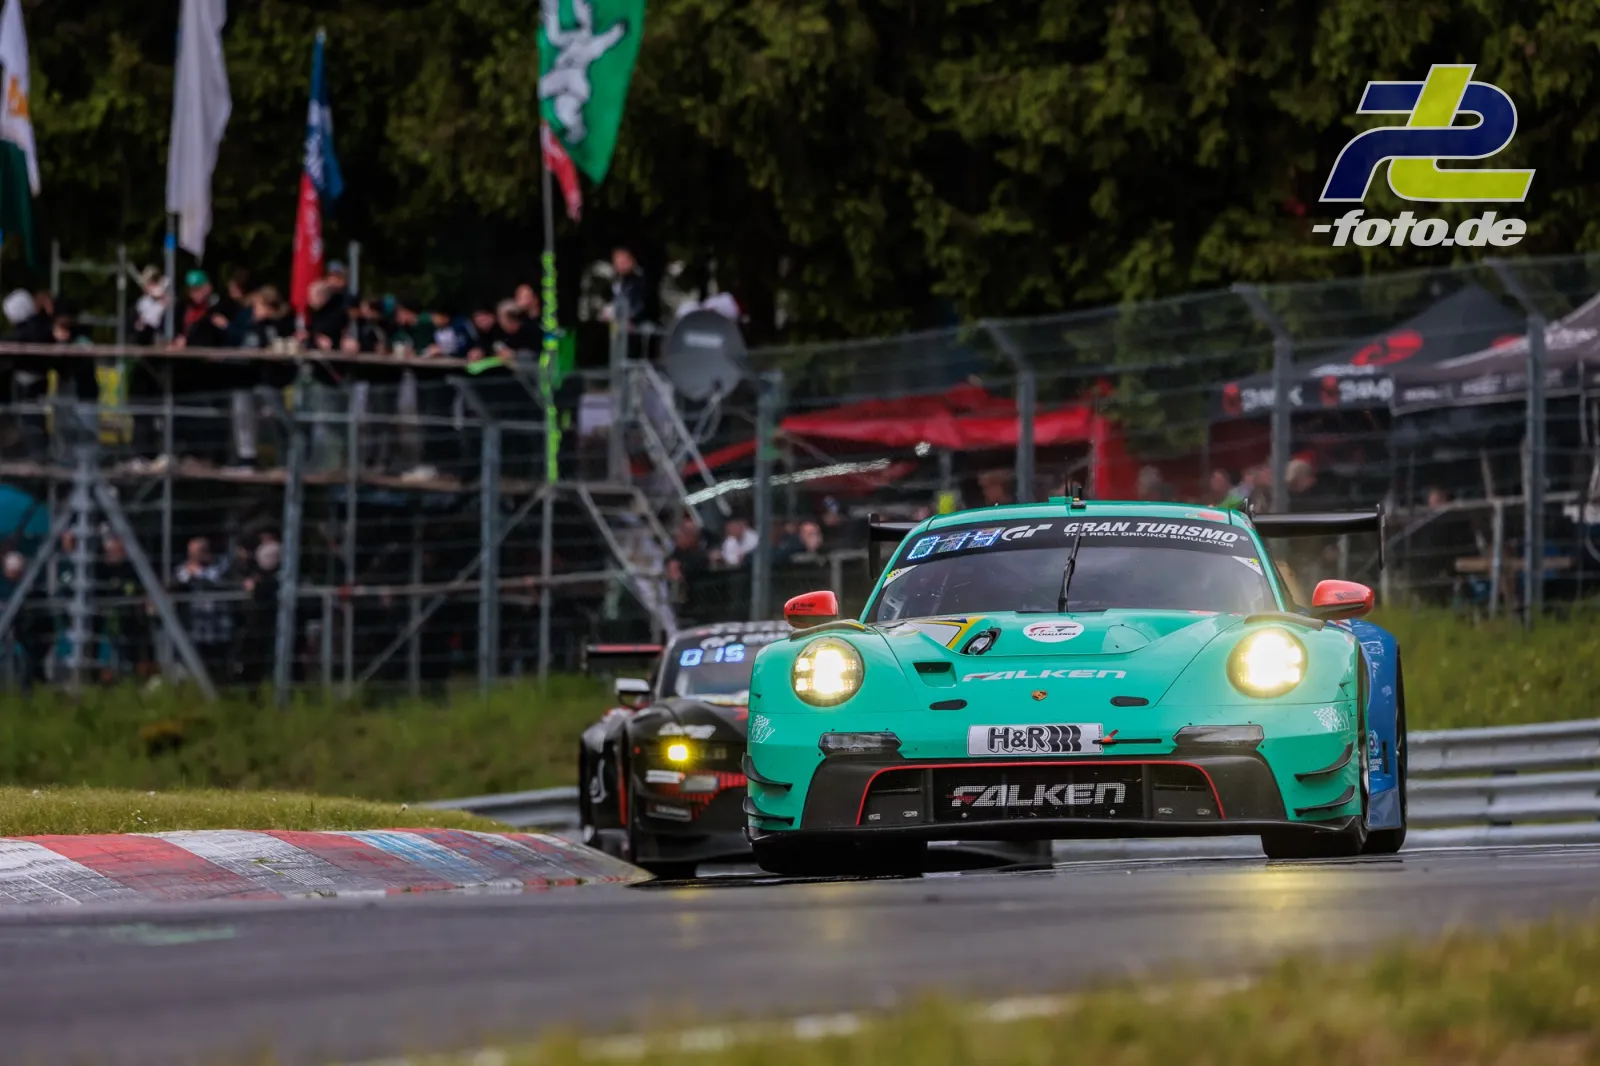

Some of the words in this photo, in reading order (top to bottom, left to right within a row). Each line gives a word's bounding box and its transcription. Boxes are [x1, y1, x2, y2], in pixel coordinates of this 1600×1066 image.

[1063, 521, 1131, 533] GRAN
[1169, 534, 1234, 548] SIMULATOR
[962, 669, 1127, 682] FALKEN
[987, 726, 1052, 753] H&R
[950, 782, 1127, 807] FALKEN
